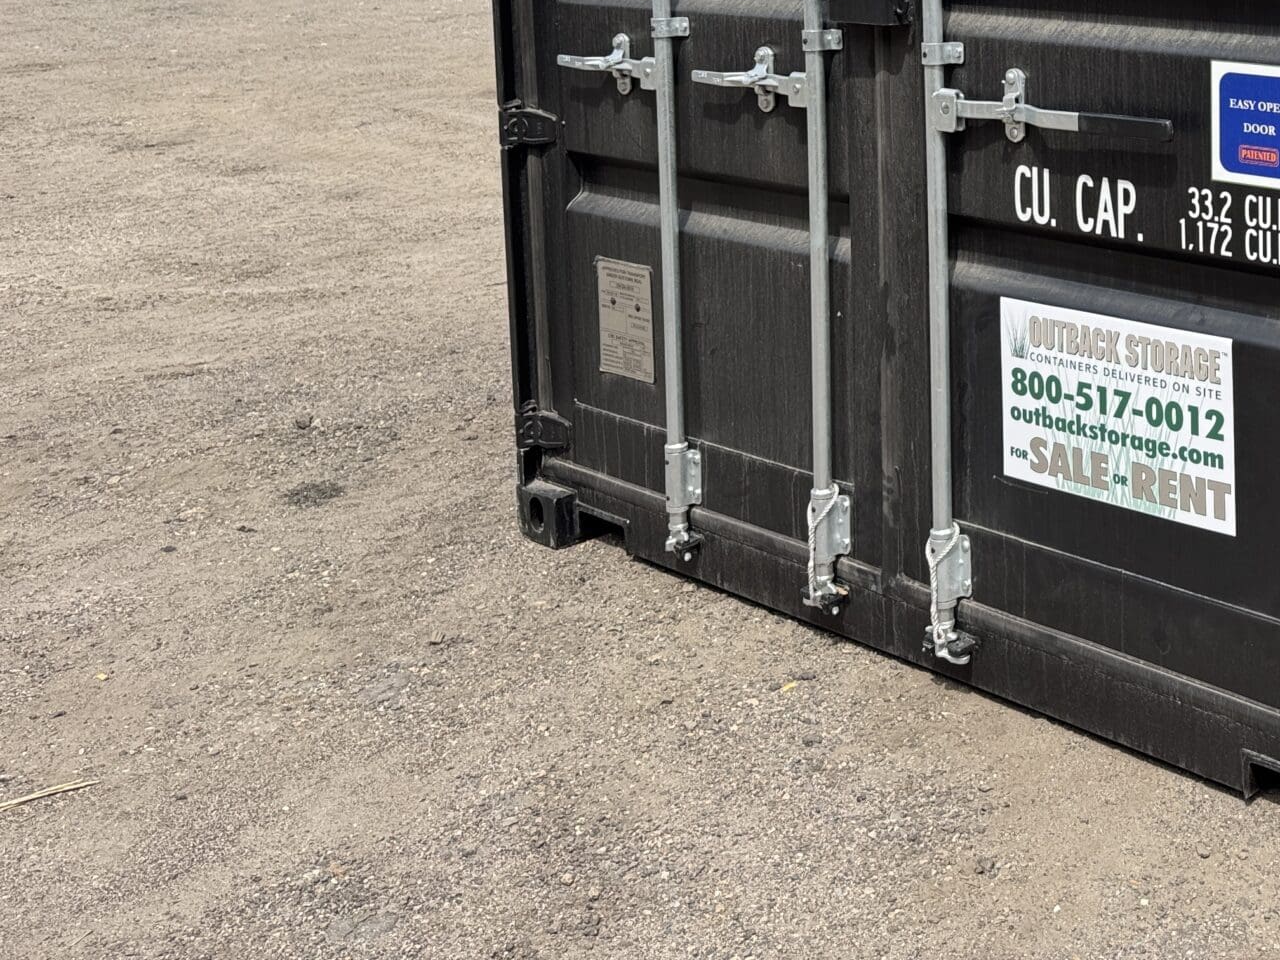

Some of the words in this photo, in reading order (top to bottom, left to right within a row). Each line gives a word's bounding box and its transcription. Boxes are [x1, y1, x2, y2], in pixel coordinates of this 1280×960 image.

[1229, 98, 1256, 111] EASY
[1243, 123, 1276, 136] DOOR
[1241, 149, 1277, 163] PATENTED
[1014, 165, 1056, 227] CU.
[1076, 174, 1143, 242] CAP.
[1187, 187, 1232, 224] 33.2
[1179, 218, 1232, 257] 1,172
[1028, 315, 1121, 365] OUTBACK
[1030, 352, 1098, 375] CONTAINERS
[1103, 366, 1167, 389] DELIVERED
[1172, 382, 1190, 395] ON
[1195, 386, 1222, 400] SITE
[1010, 367, 1225, 441] 800-517-0012
[1010, 405, 1224, 469] outbackstorage.com
[1010, 446, 1028, 461] FOR
[1029, 436, 1109, 491] SALE
[1113, 473, 1128, 486] OR
[1131, 461, 1231, 521] RENT
